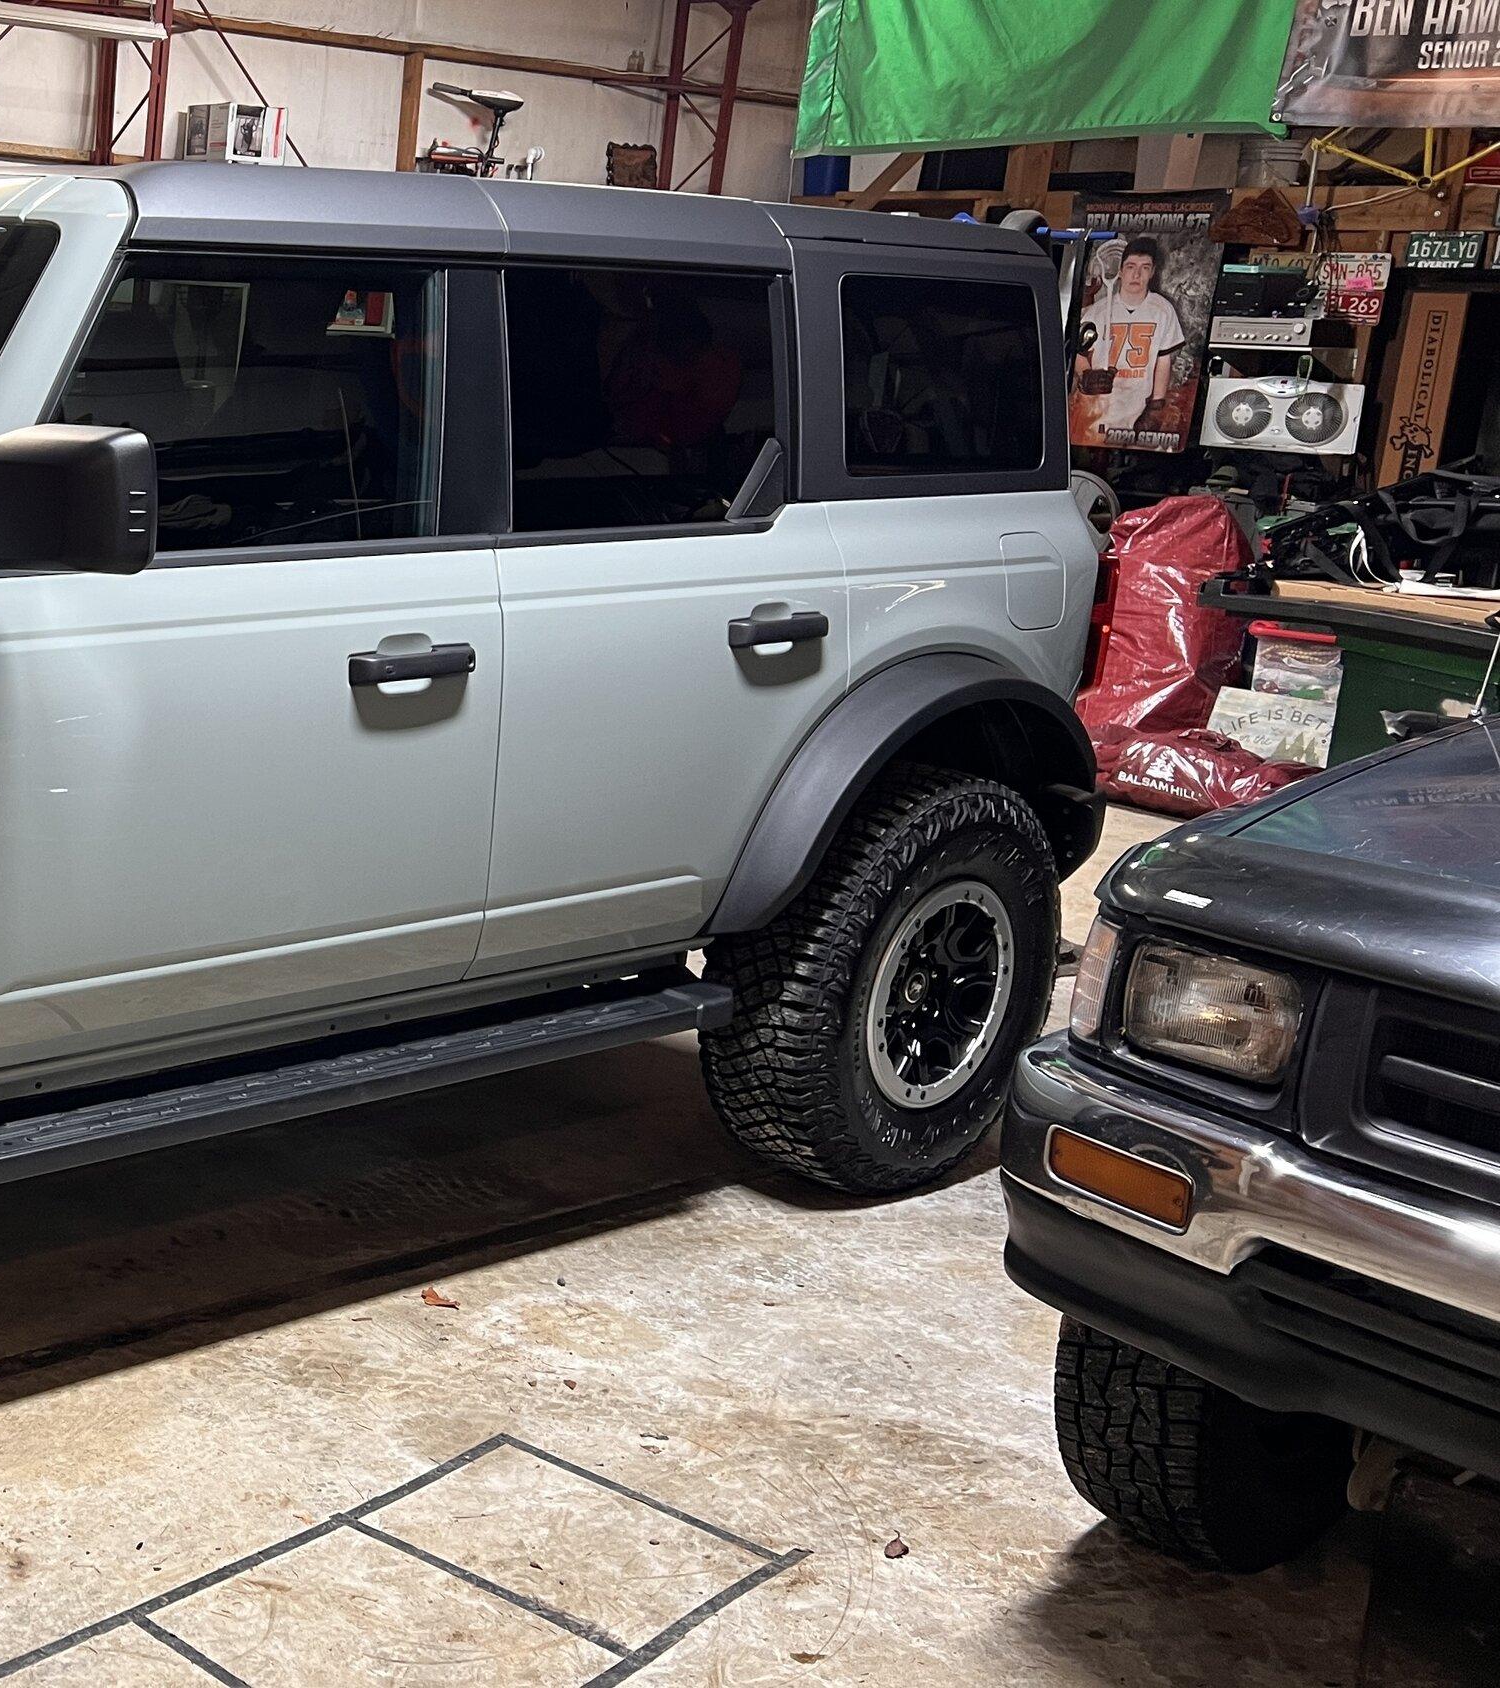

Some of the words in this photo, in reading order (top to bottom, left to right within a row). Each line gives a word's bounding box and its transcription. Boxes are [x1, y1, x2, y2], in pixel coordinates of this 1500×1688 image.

[1350, 0, 1414, 36] BEN
[1422, 0, 1500, 35] ARM
[1418, 40, 1490, 69] SENIOR
[1087, 213, 1110, 229] BEN
[1112, 213, 1184, 229] ARMSTRONG
[1142, 203, 1173, 211] SCHOOL
[1174, 202, 1214, 212] LACROSSE
[1108, 322, 1157, 368] 75
[1413, 314, 1443, 422] DIABOLICAL
[1106, 429, 1136, 444] 2020
[1136, 431, 1180, 448] SENIOR
[1403, 449, 1417, 480] INC
[1220, 712, 1259, 738] LIFE
[1268, 709, 1283, 721] IS
[1117, 771, 1169, 792] BALSAM
[1170, 785, 1199, 802] HILL
